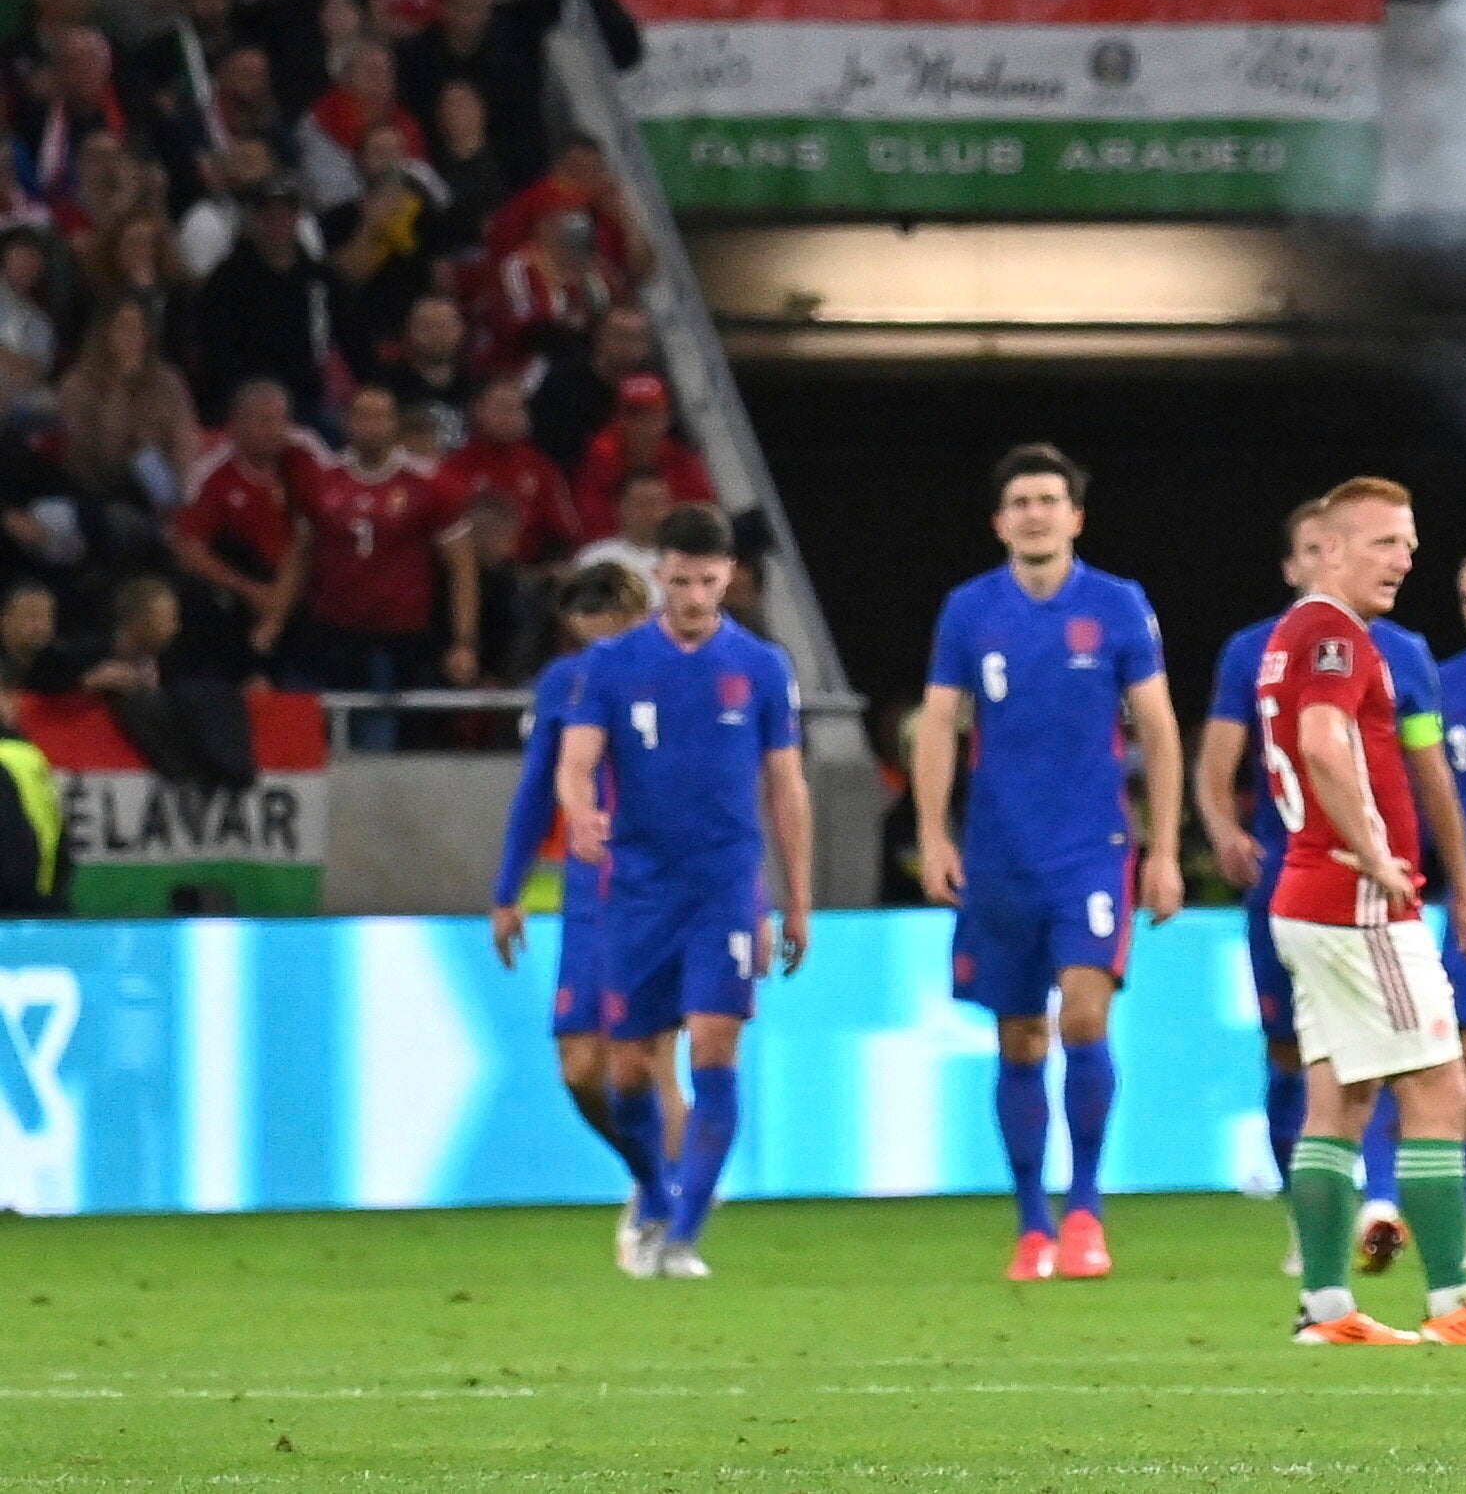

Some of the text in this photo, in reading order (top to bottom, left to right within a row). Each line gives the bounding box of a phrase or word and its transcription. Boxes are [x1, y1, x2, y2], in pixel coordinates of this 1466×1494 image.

[689, 135, 830, 172] FANS
[867, 137, 1025, 176] CLUB
[982, 651, 1008, 703] 6
